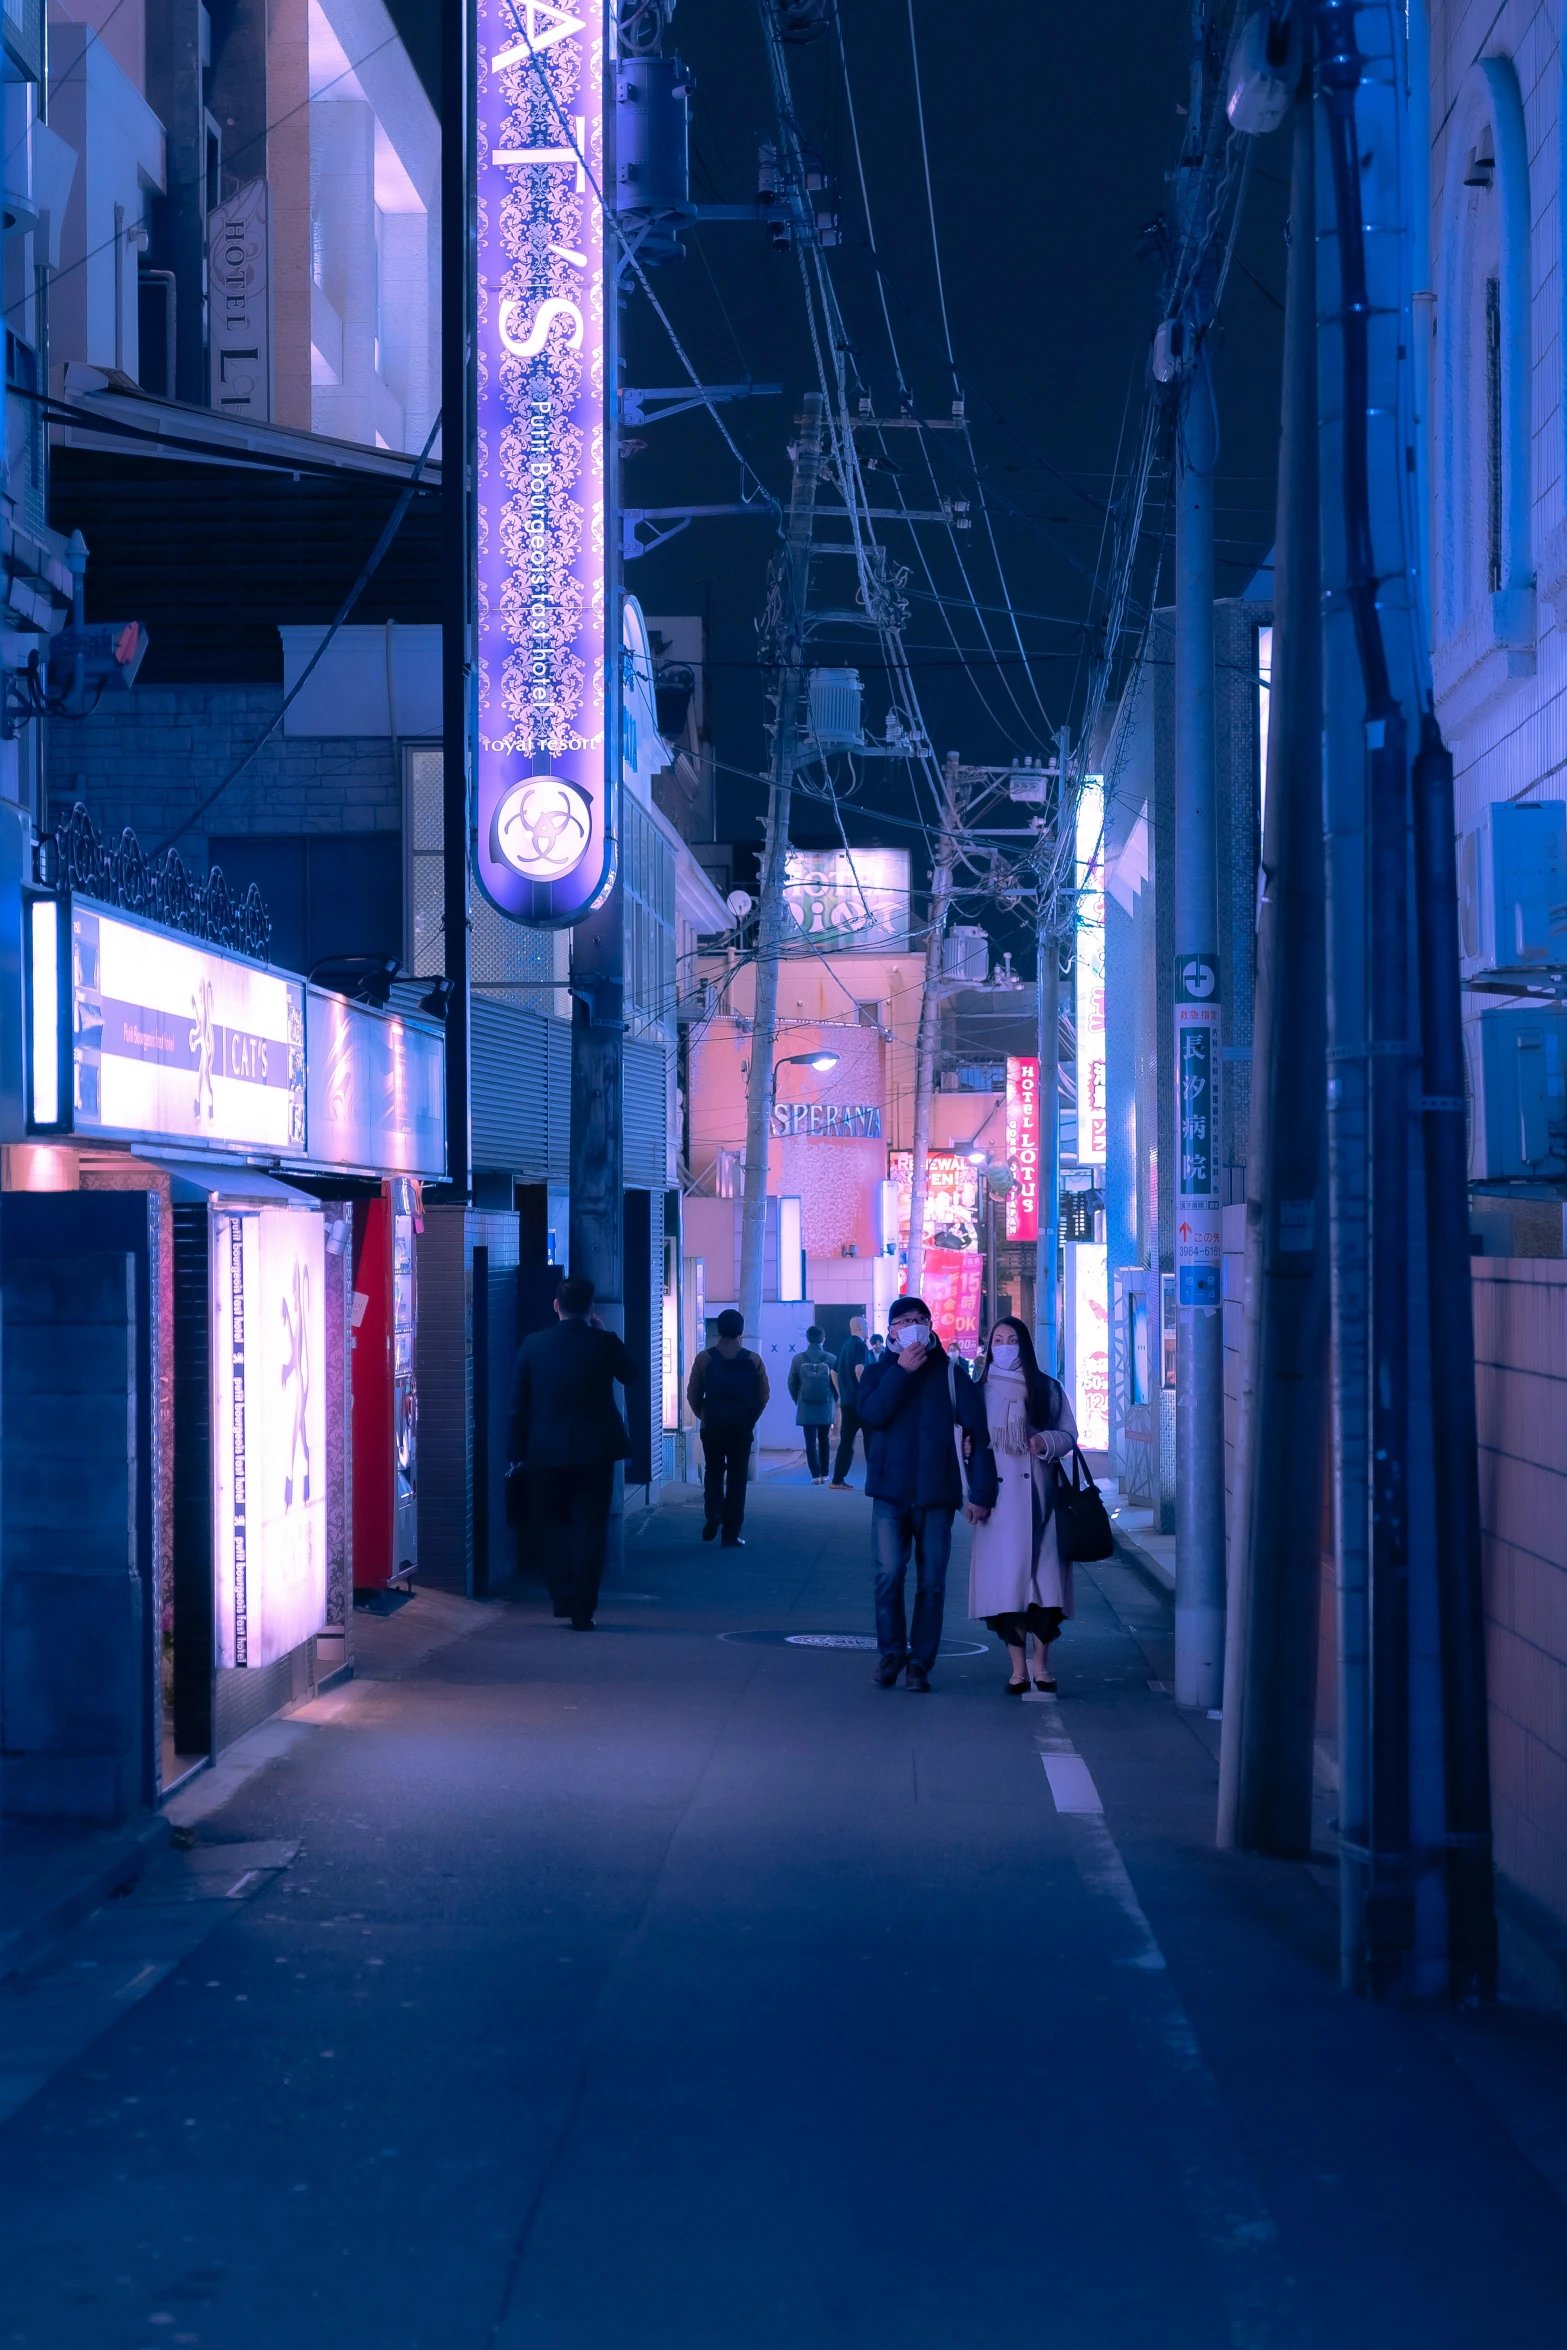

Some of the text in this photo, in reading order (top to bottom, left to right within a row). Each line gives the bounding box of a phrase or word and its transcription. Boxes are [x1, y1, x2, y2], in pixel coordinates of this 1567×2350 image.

[225, 220, 246, 331] HOTEL
[525, 401, 555, 706] Putit Bourgeois fast hotel
[484, 737, 597, 756] royal resort
[1180, 1010, 1217, 1021] 救急指定
[231, 1034, 268, 1078] CAT'S
[771, 1103, 882, 1138] SPERANZA
[1020, 1066, 1036, 1213] HOTEL LOTUS
[1182, 1034, 1206, 1180] 長汐病院
[1179, 1246, 1221, 1257] 3984-6161
[1194, 1232, 1220, 1243] この先
[230, 1218, 244, 1342] putit bourgeois fast hotel
[955, 1316, 976, 1331] OK
[232, 1377, 245, 1503] putit bourgeois fast hotel
[234, 1536, 247, 1663] putit bourgeois fast hotel
